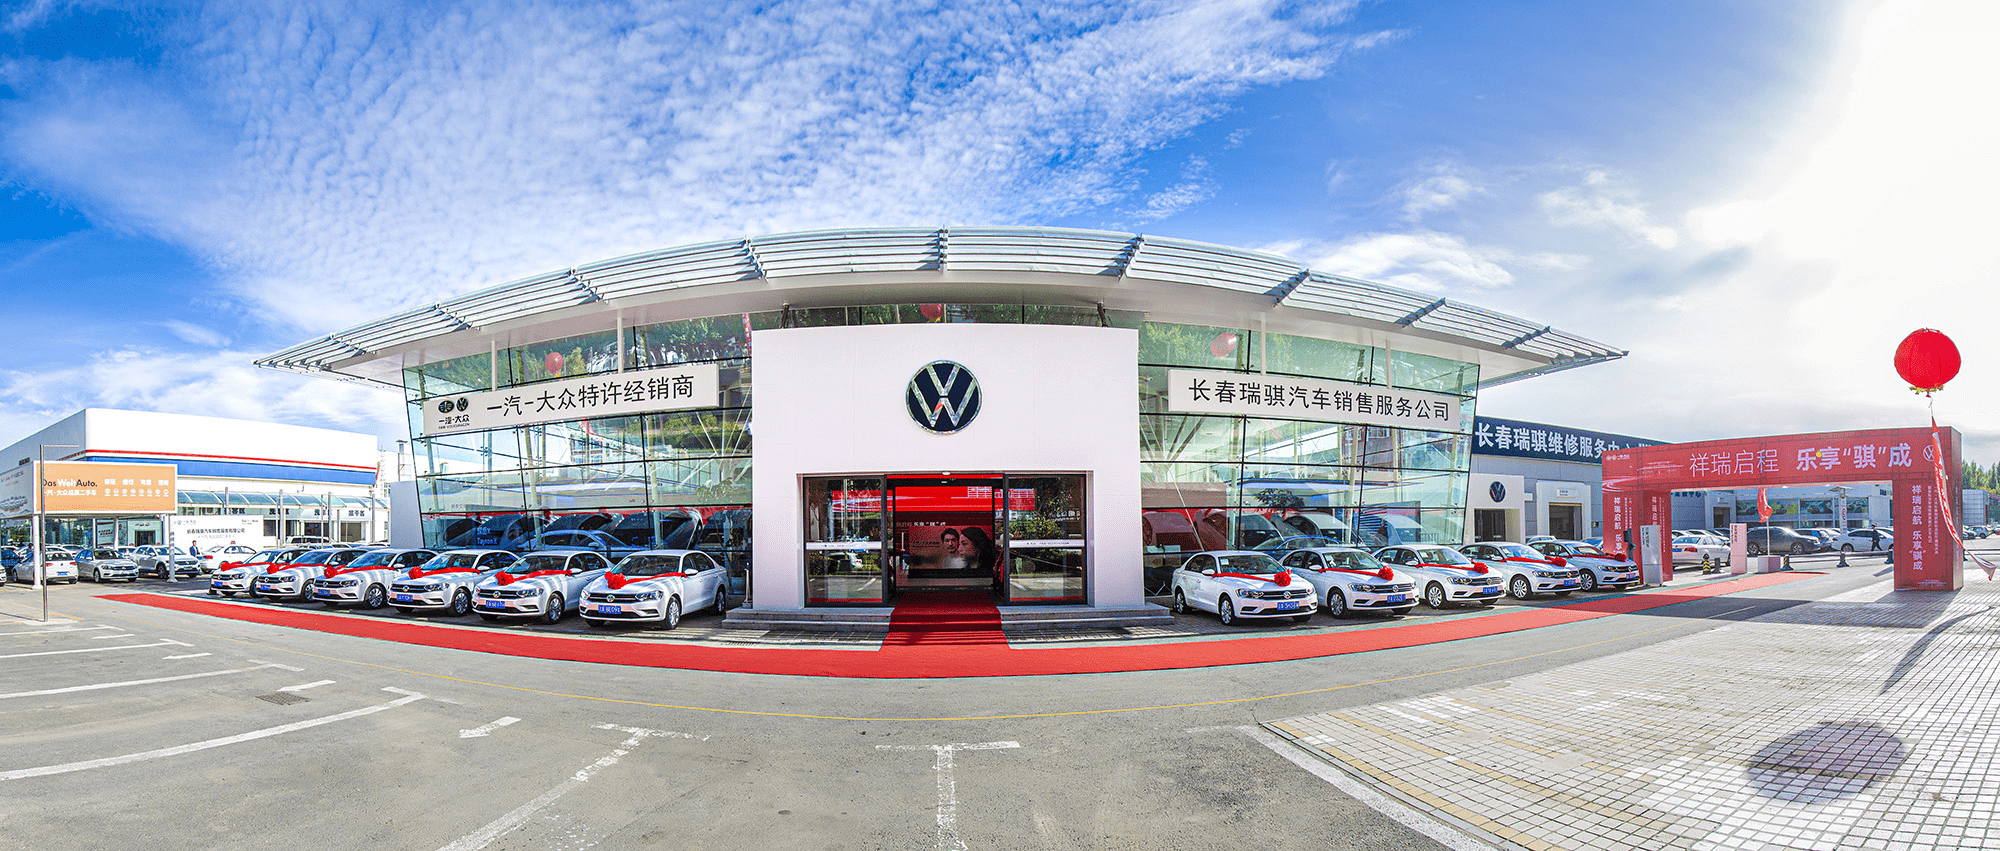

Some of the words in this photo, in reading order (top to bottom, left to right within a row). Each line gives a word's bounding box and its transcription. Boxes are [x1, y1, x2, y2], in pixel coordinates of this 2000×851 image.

[486, 374, 695, 417] 一汽-大众特许经销商
[1188, 378, 1450, 421] 长春瑞骐汽车销售服务公司
[1688, 448, 1780, 478] 祥瑞启程
[1911, 484, 1923, 526] 祥瑞启航
